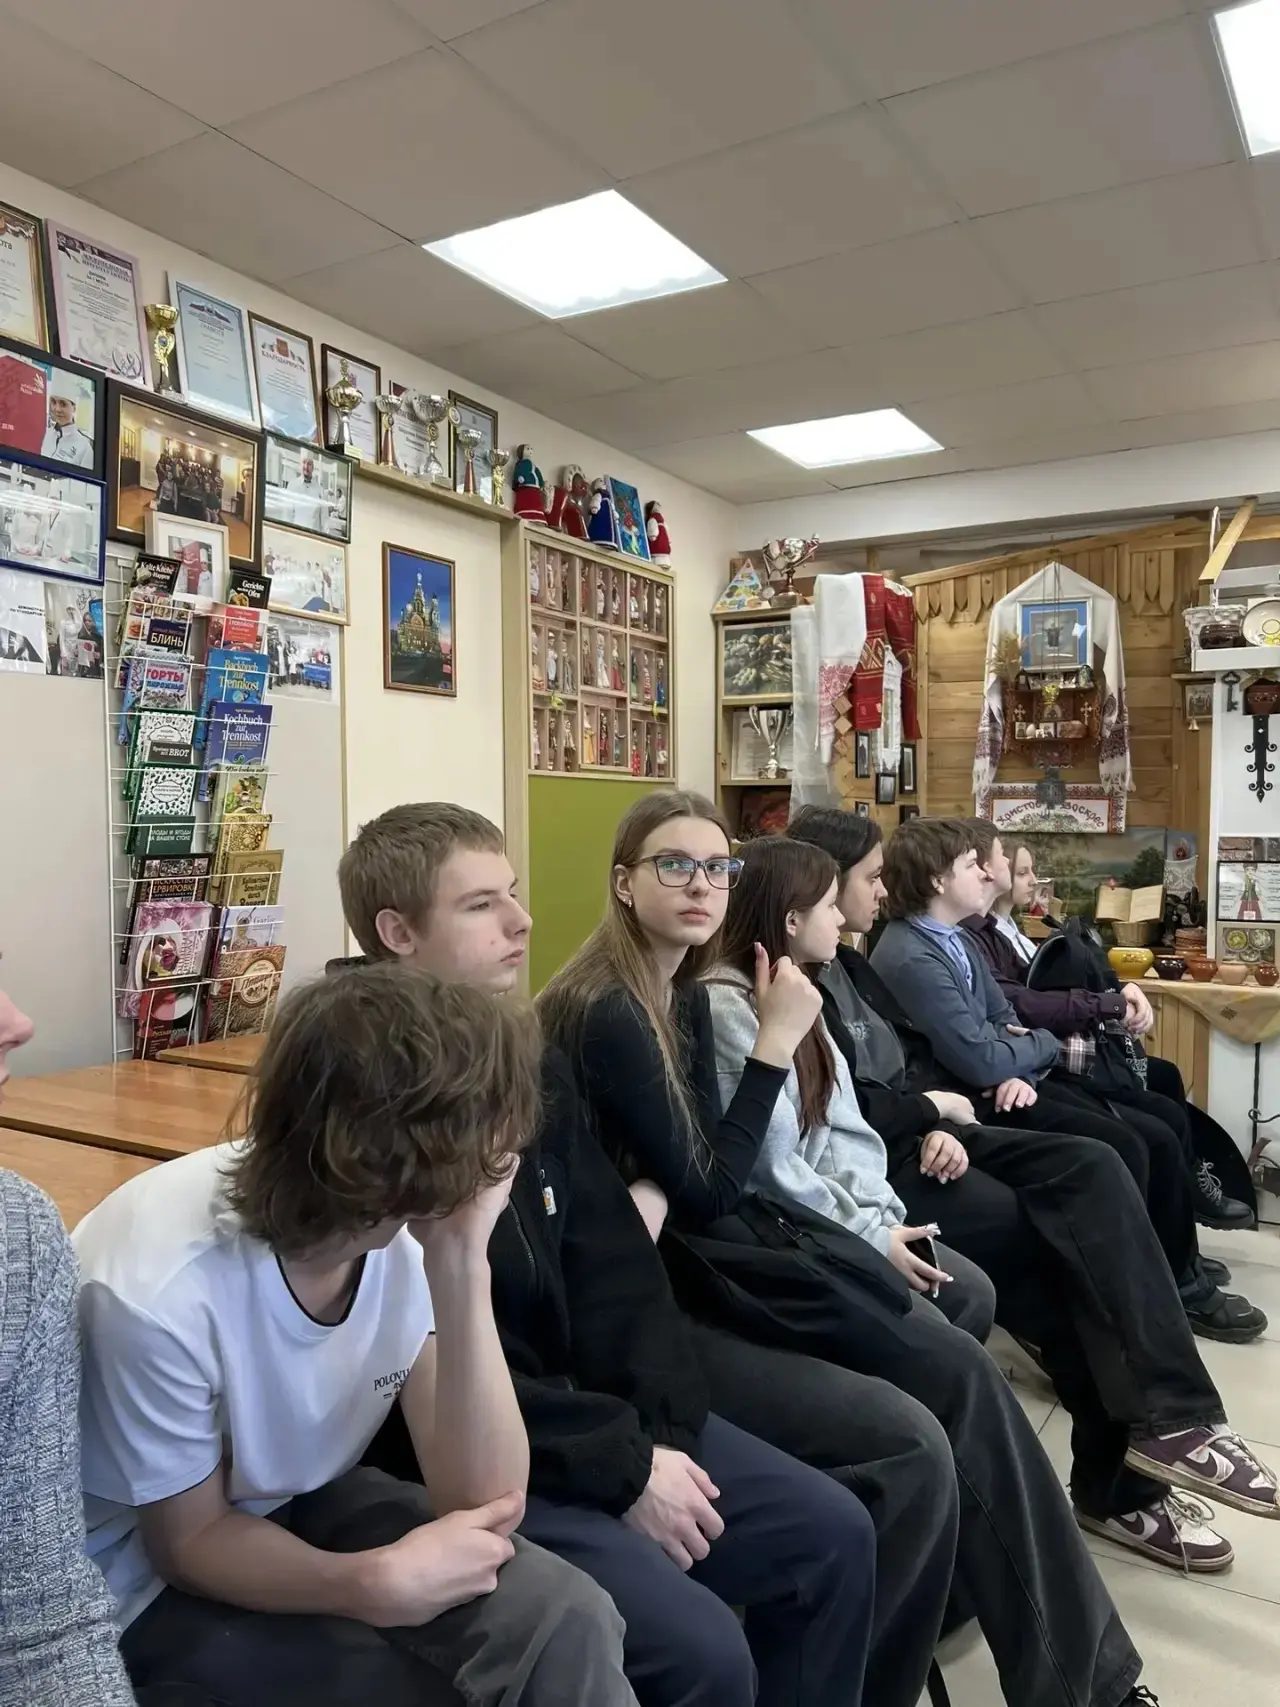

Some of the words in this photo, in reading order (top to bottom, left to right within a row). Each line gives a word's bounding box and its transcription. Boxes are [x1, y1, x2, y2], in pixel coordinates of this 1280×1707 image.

[242, 580, 264, 591] Gerichte
[248, 590, 260, 598] Ofen
[144, 668, 184, 682] ТОРТЫ
[219, 676, 259, 691] Trennkost
[224, 713, 263, 725] Kochbuch
[235, 724, 246, 732] zur
[222, 728, 261, 741] Trennkost
[169, 748, 189, 757] BROT
[996, 801, 1042, 826] Христос
[1060, 801, 1105, 828] Воскрес
[147, 884, 196, 894] СЕРВИРОВК
